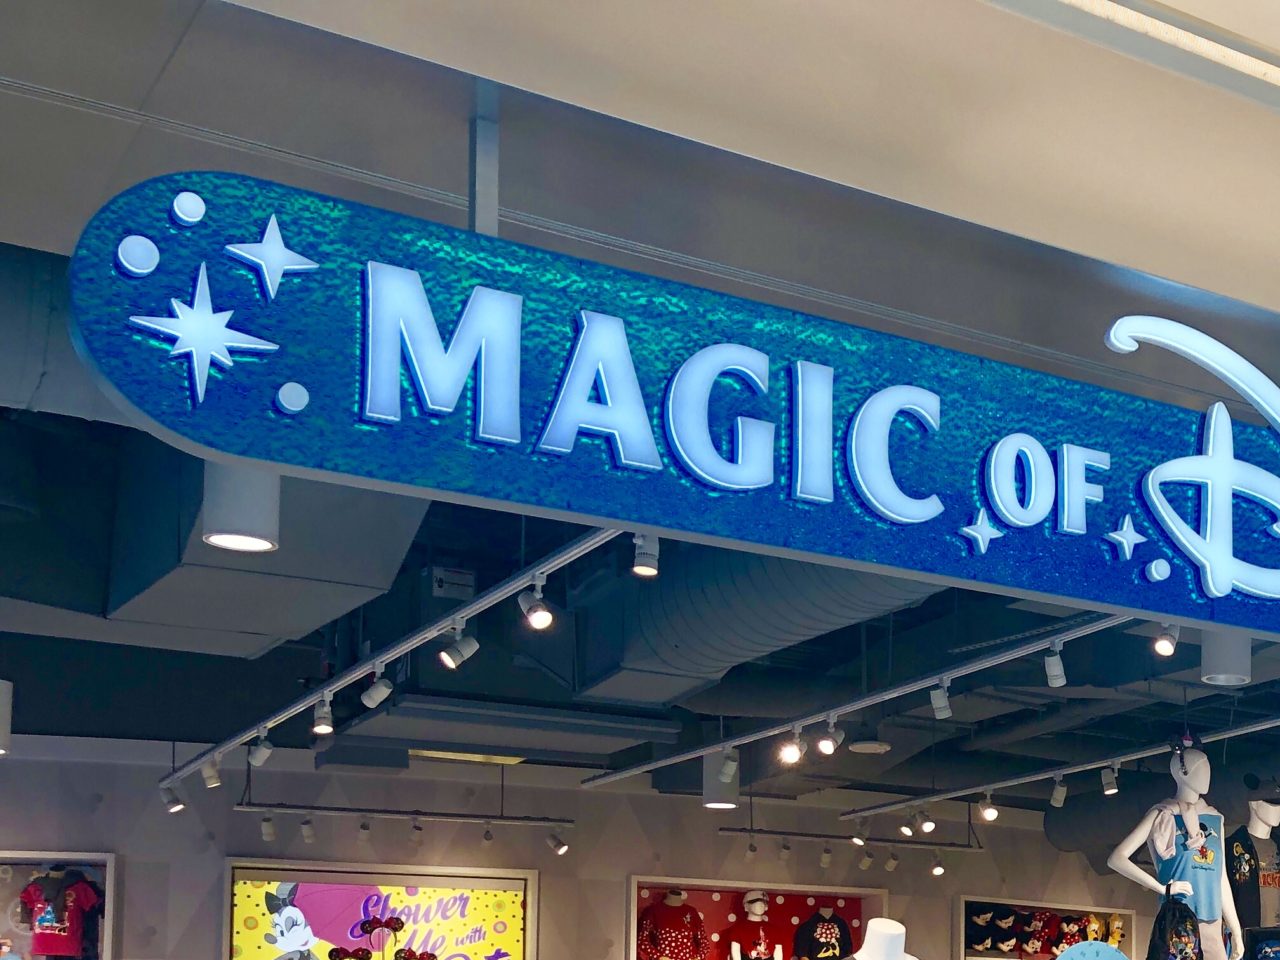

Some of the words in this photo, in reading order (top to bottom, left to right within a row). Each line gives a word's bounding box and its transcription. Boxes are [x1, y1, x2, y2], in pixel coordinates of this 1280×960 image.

[360, 259, 946, 526] MAGIC
[983, 431, 1112, 536] OF
[348, 892, 471, 940] Shower
[454, 924, 487, 948] with
